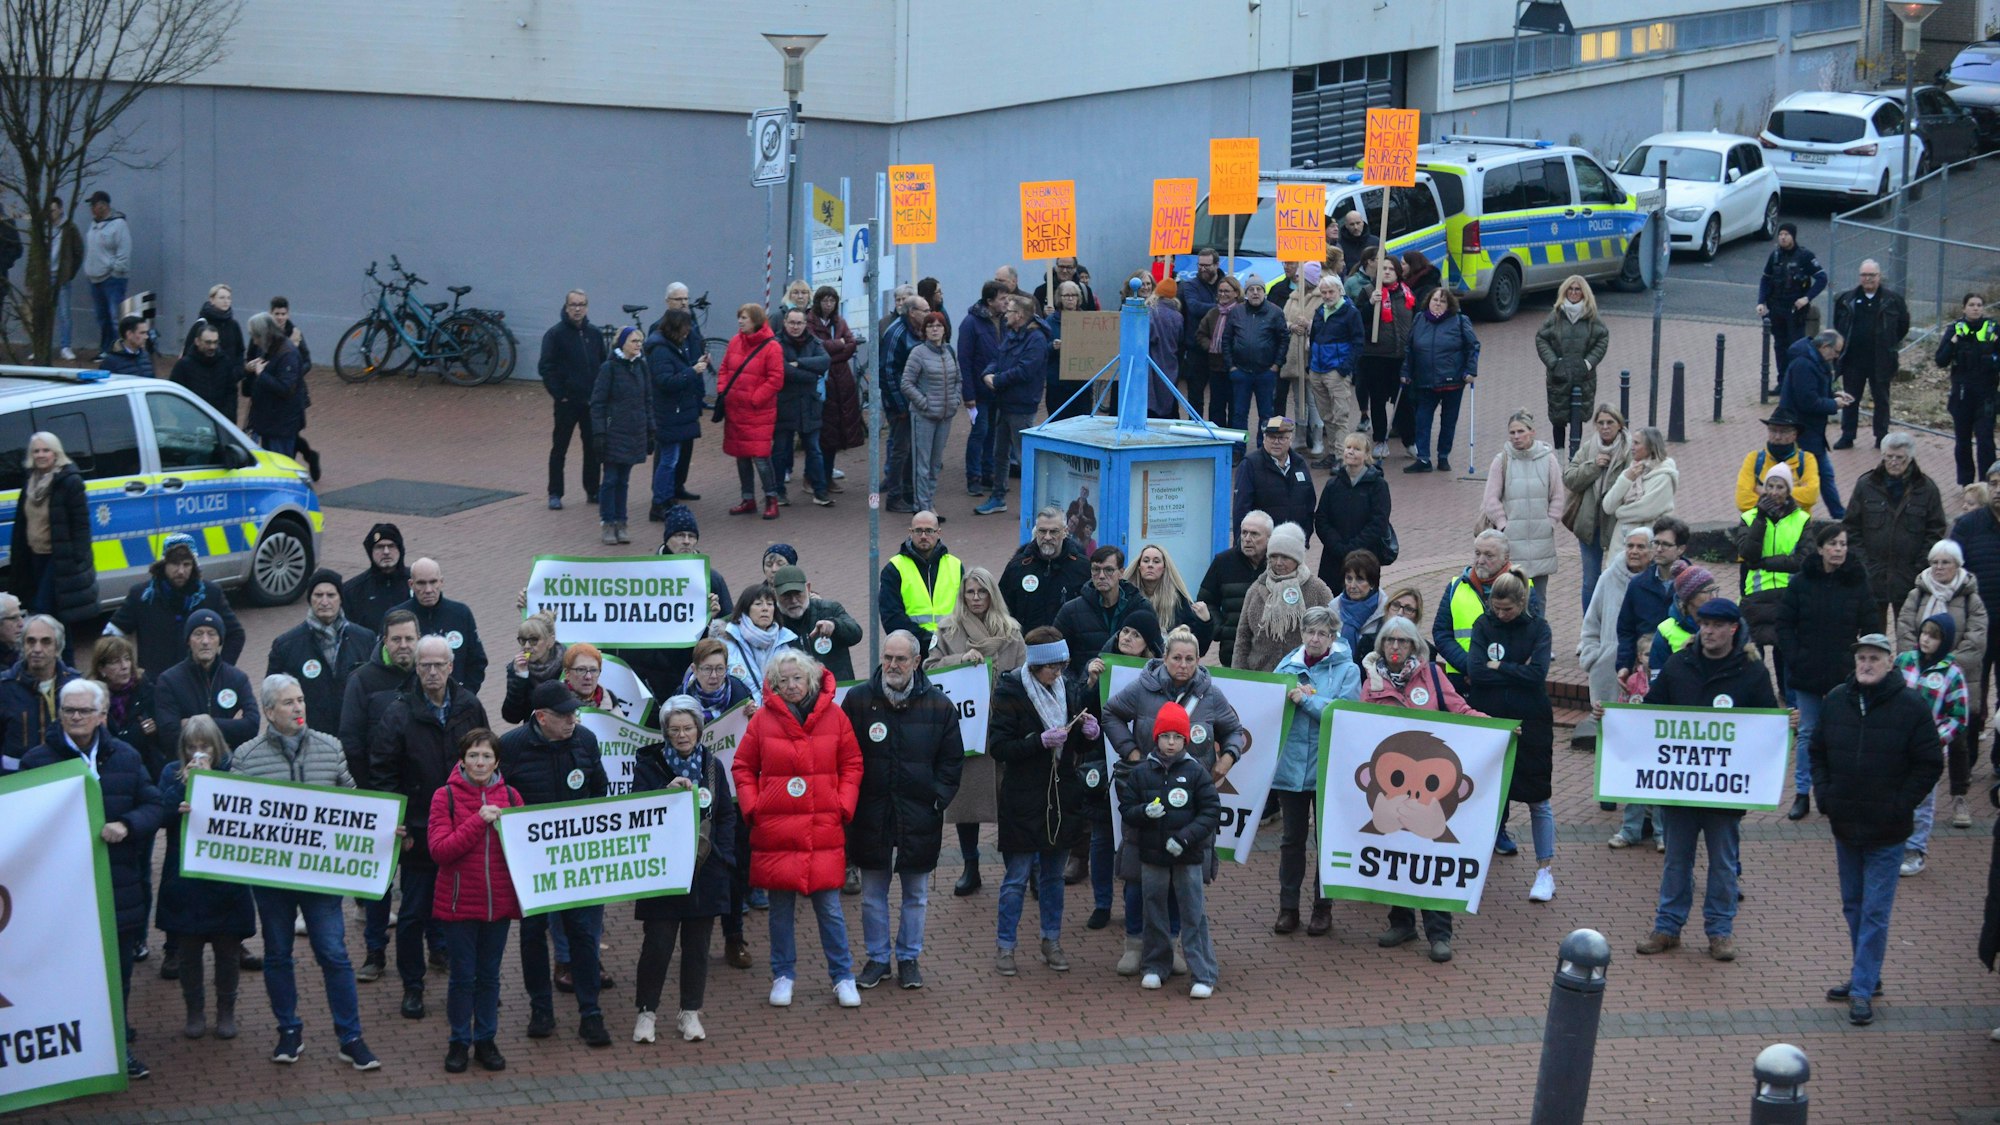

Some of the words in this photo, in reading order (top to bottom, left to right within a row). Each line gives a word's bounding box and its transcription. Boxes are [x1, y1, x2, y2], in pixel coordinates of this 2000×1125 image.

[1370, 114, 1414, 130] NICHT
[765, 131, 778, 150] 30
[1369, 131, 1413, 148] MEINE
[1215, 161, 1256, 175] NICHT
[1366, 165, 1410, 182] INITIATIVE
[1219, 175, 1253, 189] MEIN
[895, 192, 930, 207] NICHT
[1210, 192, 1257, 206] PROTEST
[1277, 187, 1325, 204] NICHT
[896, 208, 932, 222] MEIN
[1026, 208, 1069, 223] NICHT
[1156, 206, 1191, 228] OHNE
[1279, 208, 1320, 228] MEIN
[896, 222, 932, 237] PROTEST
[1027, 223, 1071, 239] MEIN
[1588, 219, 1613, 231] POLIZEI
[1027, 237, 1071, 253] PROTEST
[1154, 229, 1190, 250] MICH
[1277, 236, 1324, 252] PROTEST
[176, 493, 228, 516] POLIZEI
[543, 574, 690, 597] KÖNIGSDORF
[604, 602, 694, 623] DIALOG!
[1654, 719, 1736, 742] DIALOG
[1657, 744, 1732, 767] STATT
[1635, 769, 1750, 794] MONOLOG!
[212, 793, 252, 815] WIR
[259, 799, 308, 822] SIND
[314, 806, 378, 831] KEINE
[527, 813, 622, 842] SCHLUSS
[629, 807, 667, 829] MIT
[206, 817, 327, 851] MELKKÜHE,
[335, 832, 375, 854] WIR
[195, 839, 293, 868] FORDERN
[298, 852, 380, 879] DIALOG!
[546, 834, 651, 865] TAUBHEIT
[533, 872, 557, 893] IM
[564, 857, 667, 888] RATHAUS!
[1358, 846, 1480, 888] STUPP
